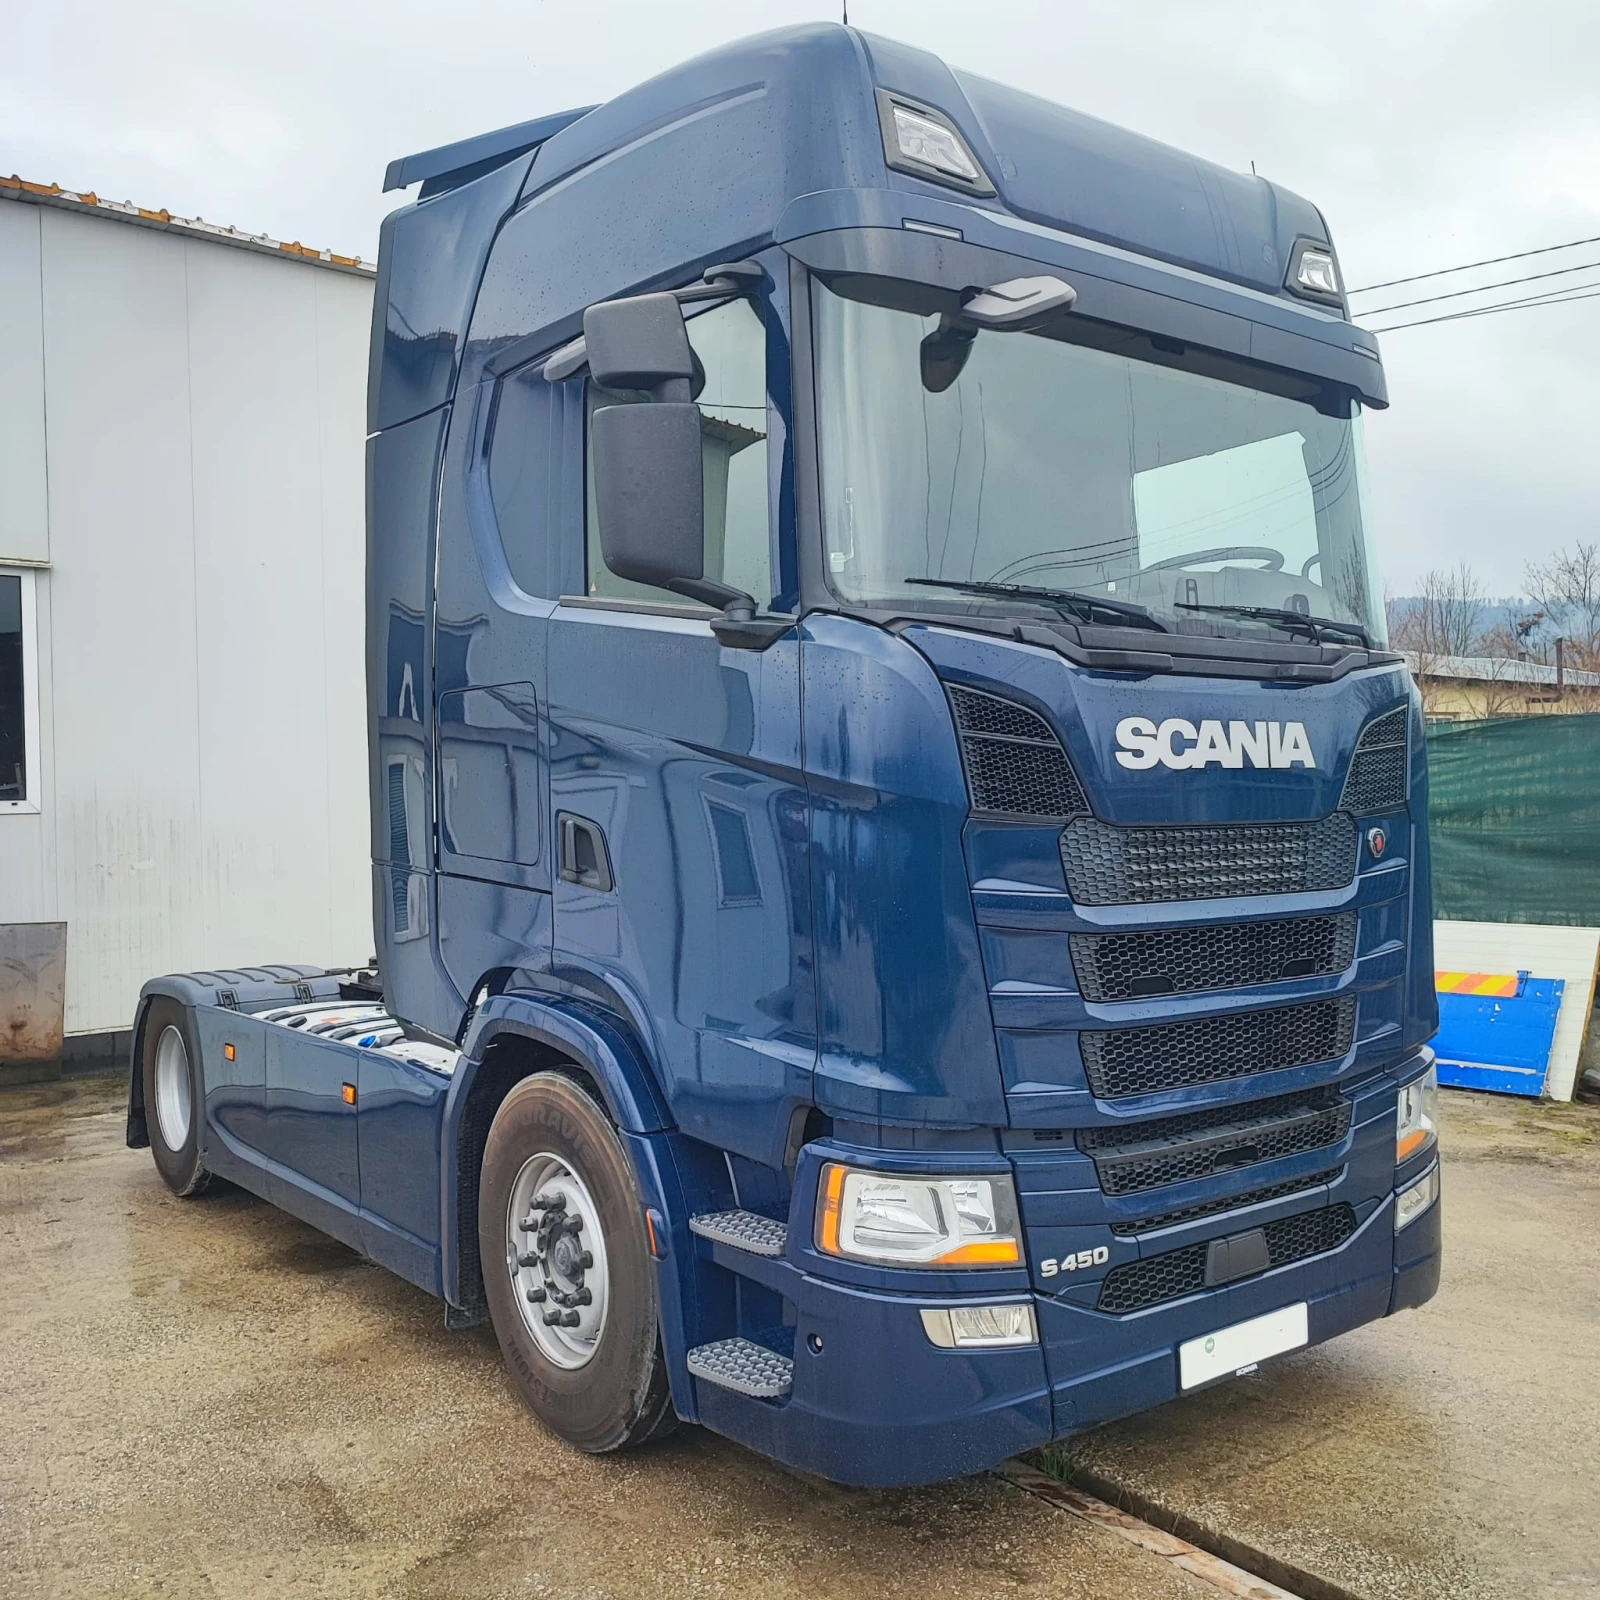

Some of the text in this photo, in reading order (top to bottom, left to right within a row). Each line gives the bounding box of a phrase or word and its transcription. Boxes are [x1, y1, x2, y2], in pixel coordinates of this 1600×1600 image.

[1115, 717, 1316, 769] SCANIA
[1041, 1246, 1109, 1278] S 450
